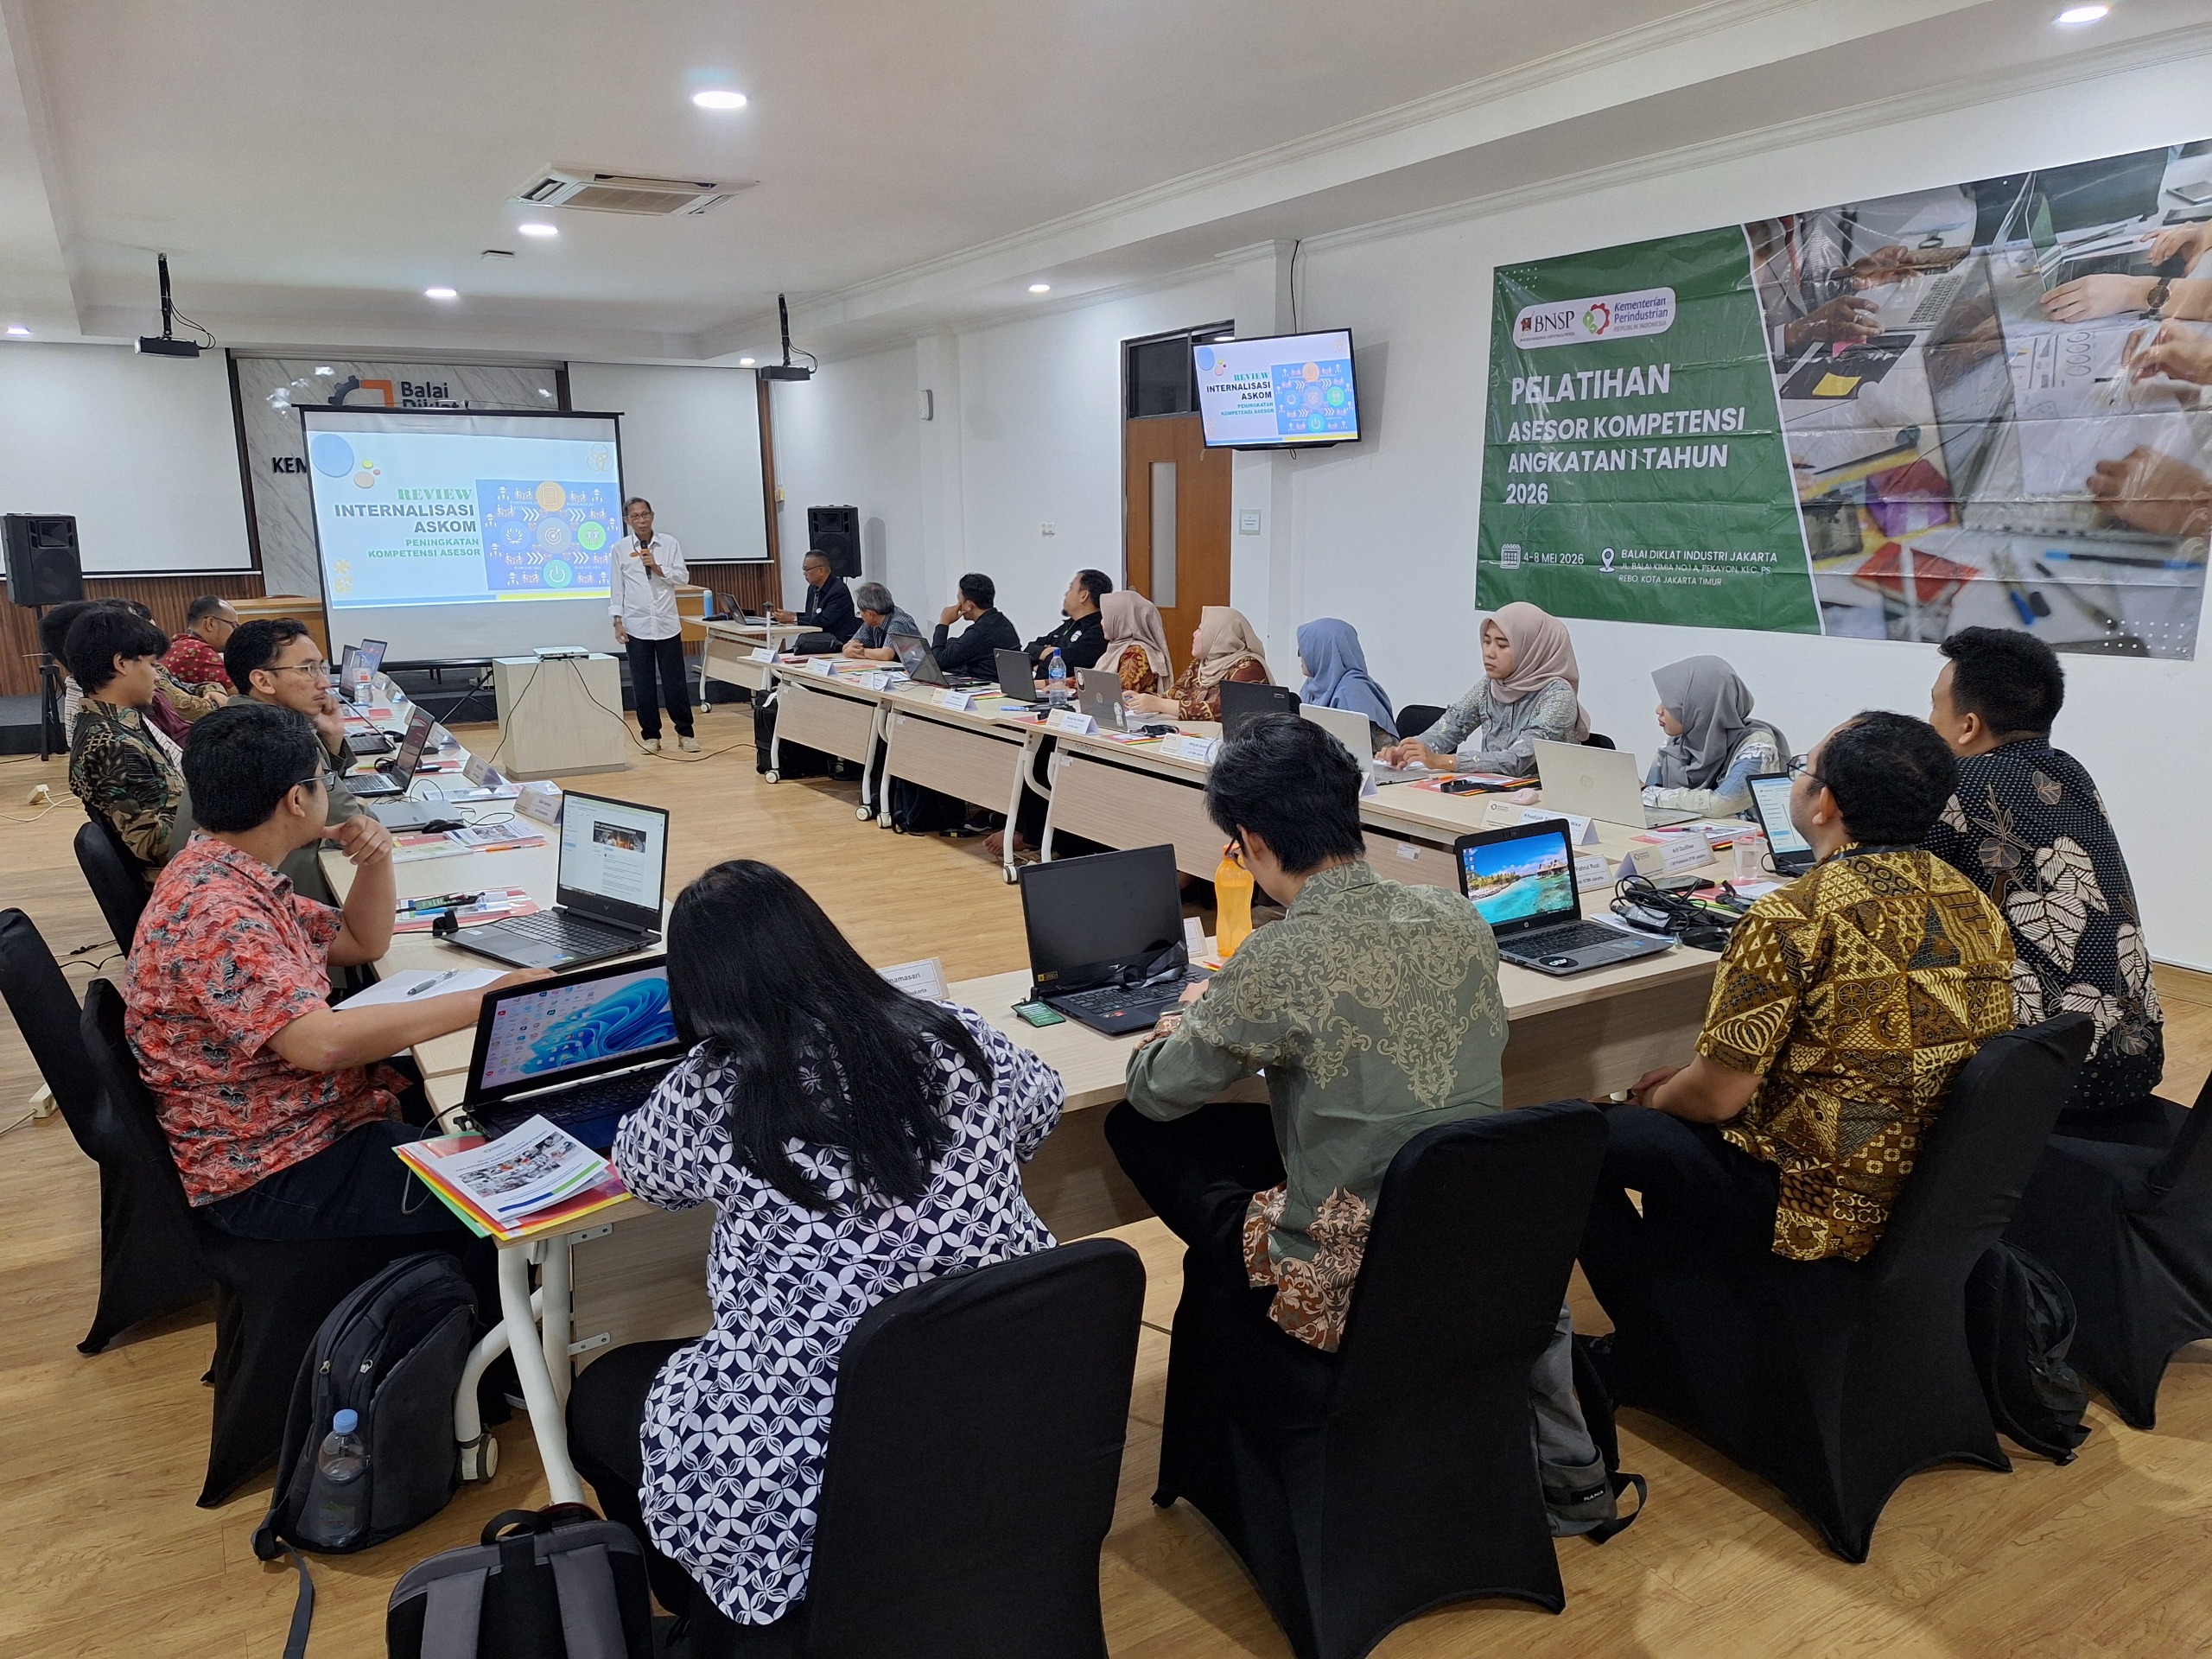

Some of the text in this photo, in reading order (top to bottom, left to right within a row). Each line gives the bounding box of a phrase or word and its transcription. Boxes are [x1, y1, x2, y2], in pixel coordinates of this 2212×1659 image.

[1614, 296, 1666, 312] Kementerian
[1535, 311, 1574, 333] BNSP
[1614, 308, 1669, 323] Perindustrian
[1234, 372, 1268, 381] REVIEW
[401, 381, 449, 398] Balai
[1206, 381, 1271, 393] INTERNALISASI
[1510, 363, 1671, 405] PELATIHAN
[1242, 391, 1272, 400] ASKOM
[1507, 407, 1745, 442] ASESOR KOMPETENSI
[1508, 444, 1728, 474] ANGKATAN I TAHUN
[397, 488, 473, 500] REVIEW
[1505, 482, 1548, 505] 2026
[334, 504, 474, 517] INTERNALISASI
[414, 520, 477, 533] ASKOM
[405, 537, 480, 547] PENINGKATAN
[368, 548, 481, 558] KOMPETENSI ASESOR
[1523, 552, 1585, 564] 4-8 MEI 2026
[1621, 549, 1777, 563] BALAI DIKLAT INDUSTRI JAKARTA
[1662, 575, 1697, 585] JAKARTA
[1699, 577, 1722, 586] TIMUR
[888, 972, 921, 984] namasari
